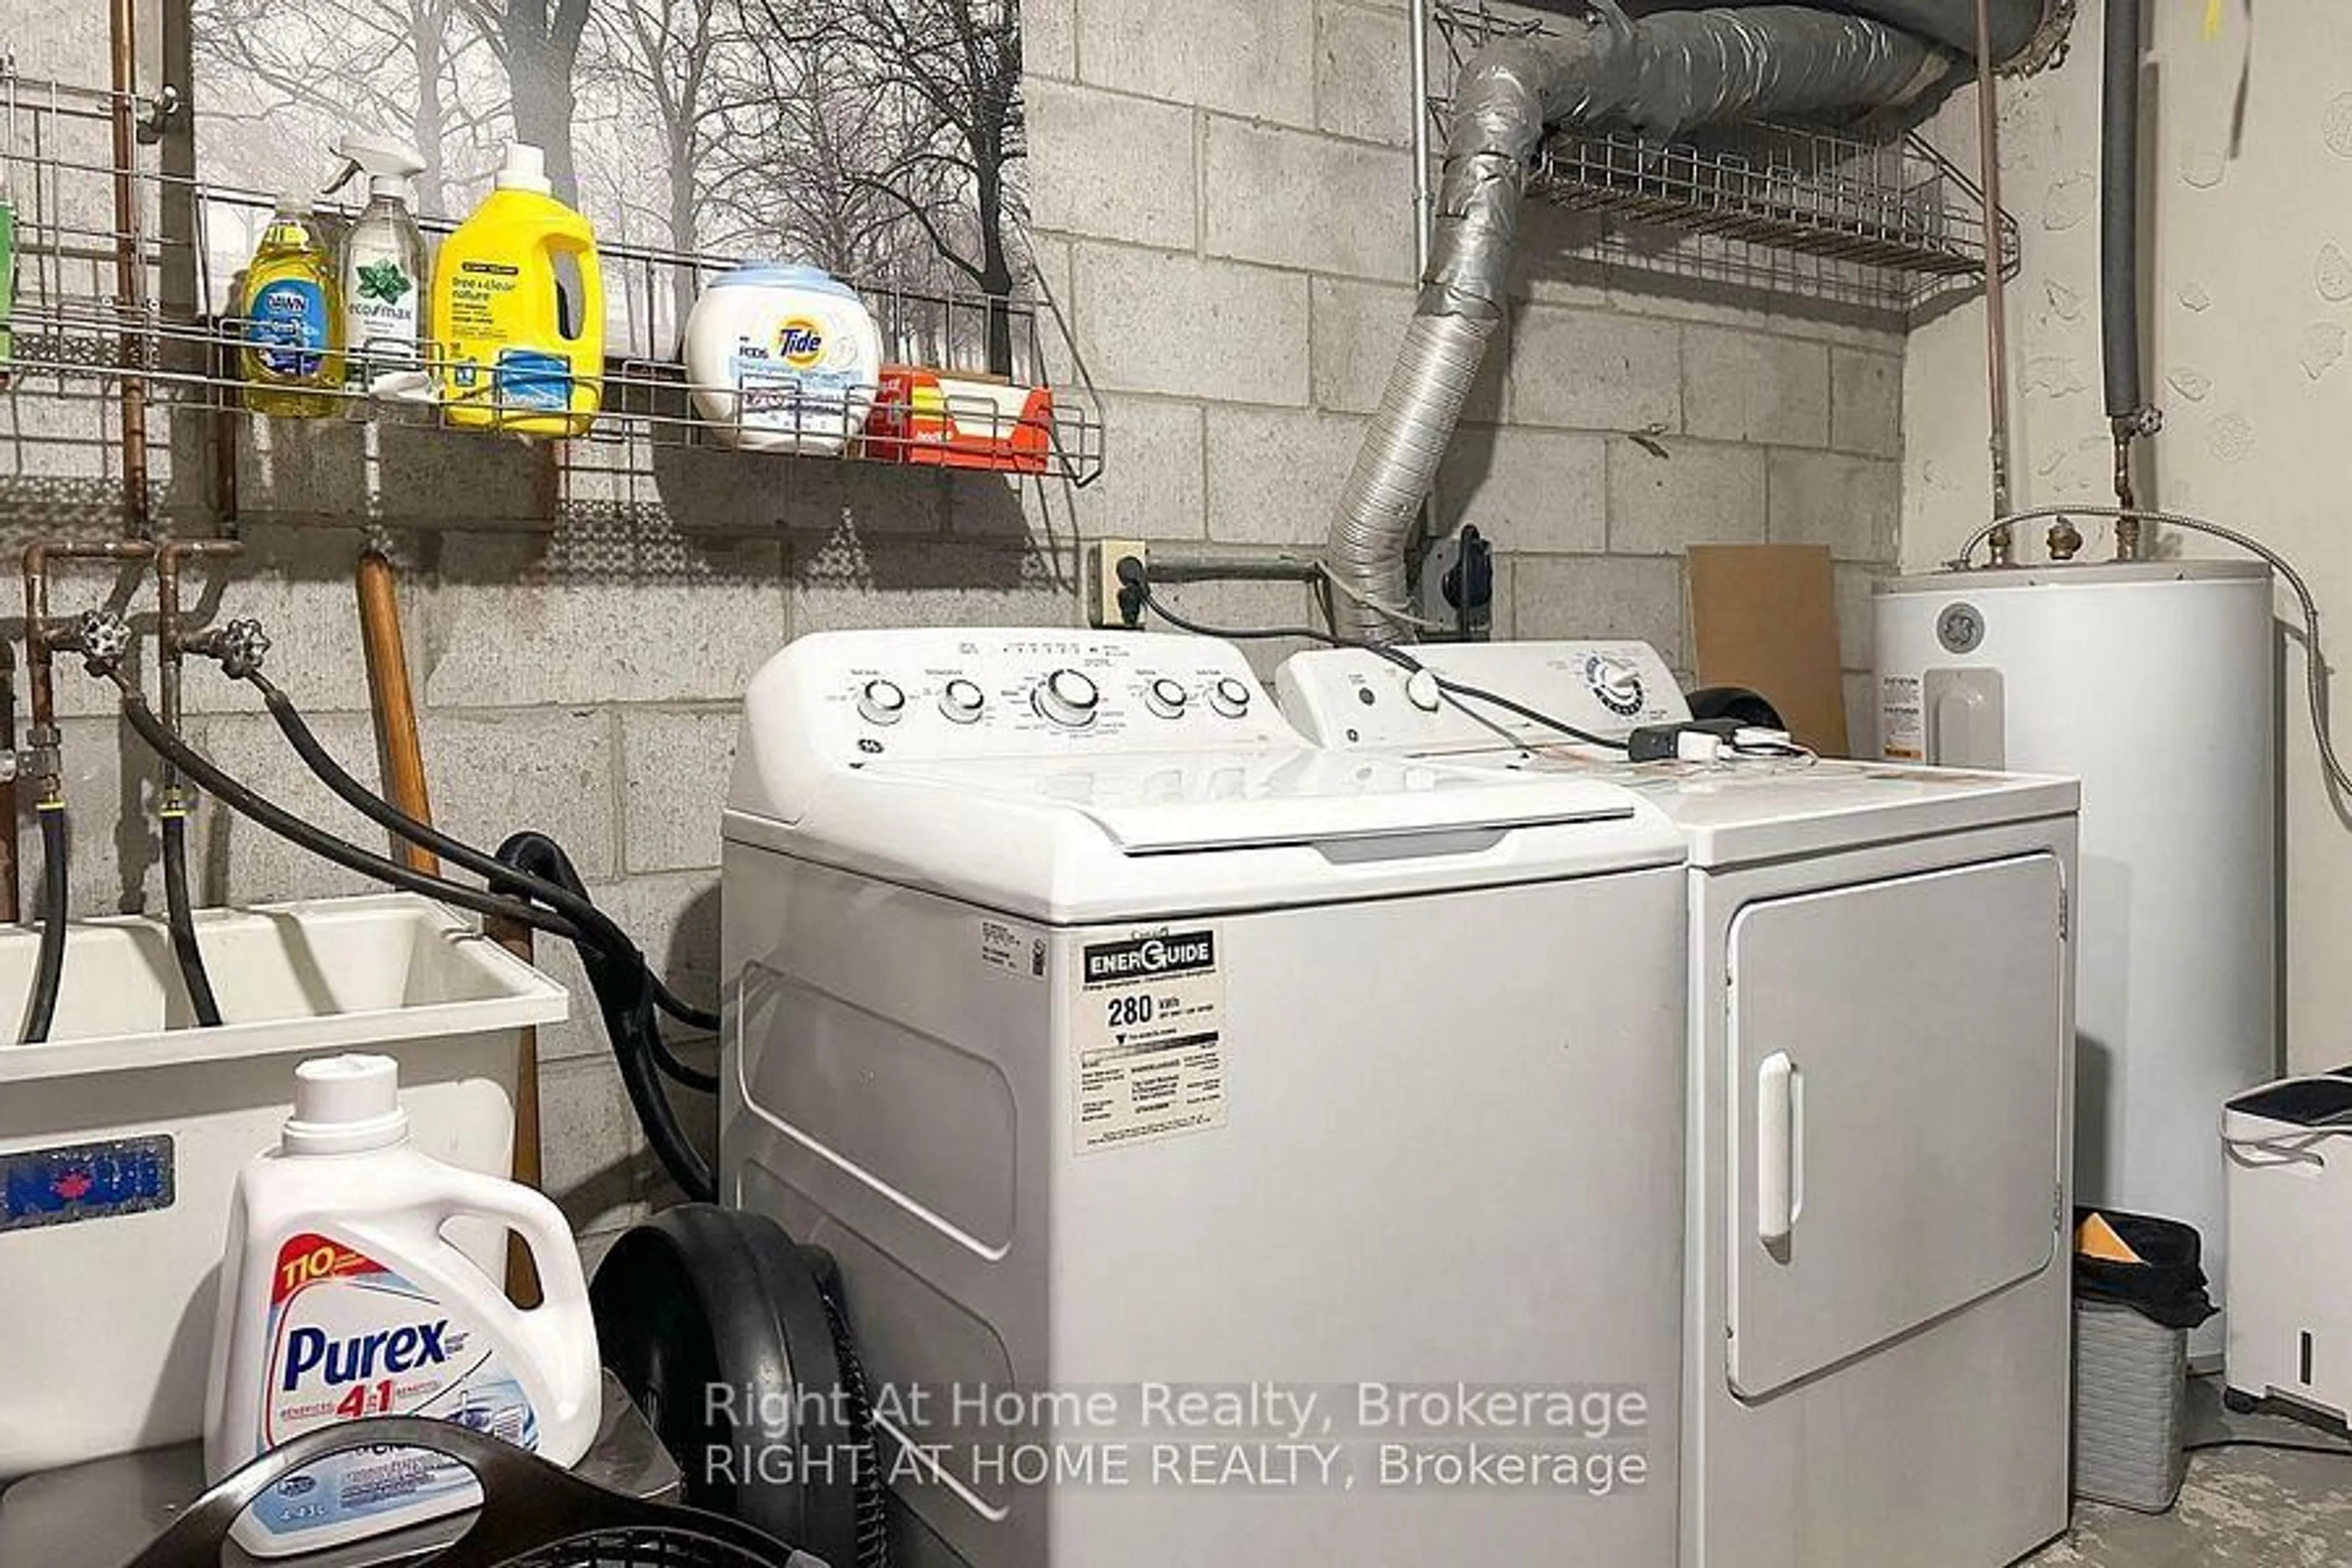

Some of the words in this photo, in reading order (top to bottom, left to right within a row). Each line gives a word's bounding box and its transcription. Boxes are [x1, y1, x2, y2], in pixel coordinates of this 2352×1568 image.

[780, 328, 821, 356] Tide
[1107, 995, 1152, 1027] 280
[282, 1246, 336, 1289] 110
[282, 1320, 448, 1391] Purex
